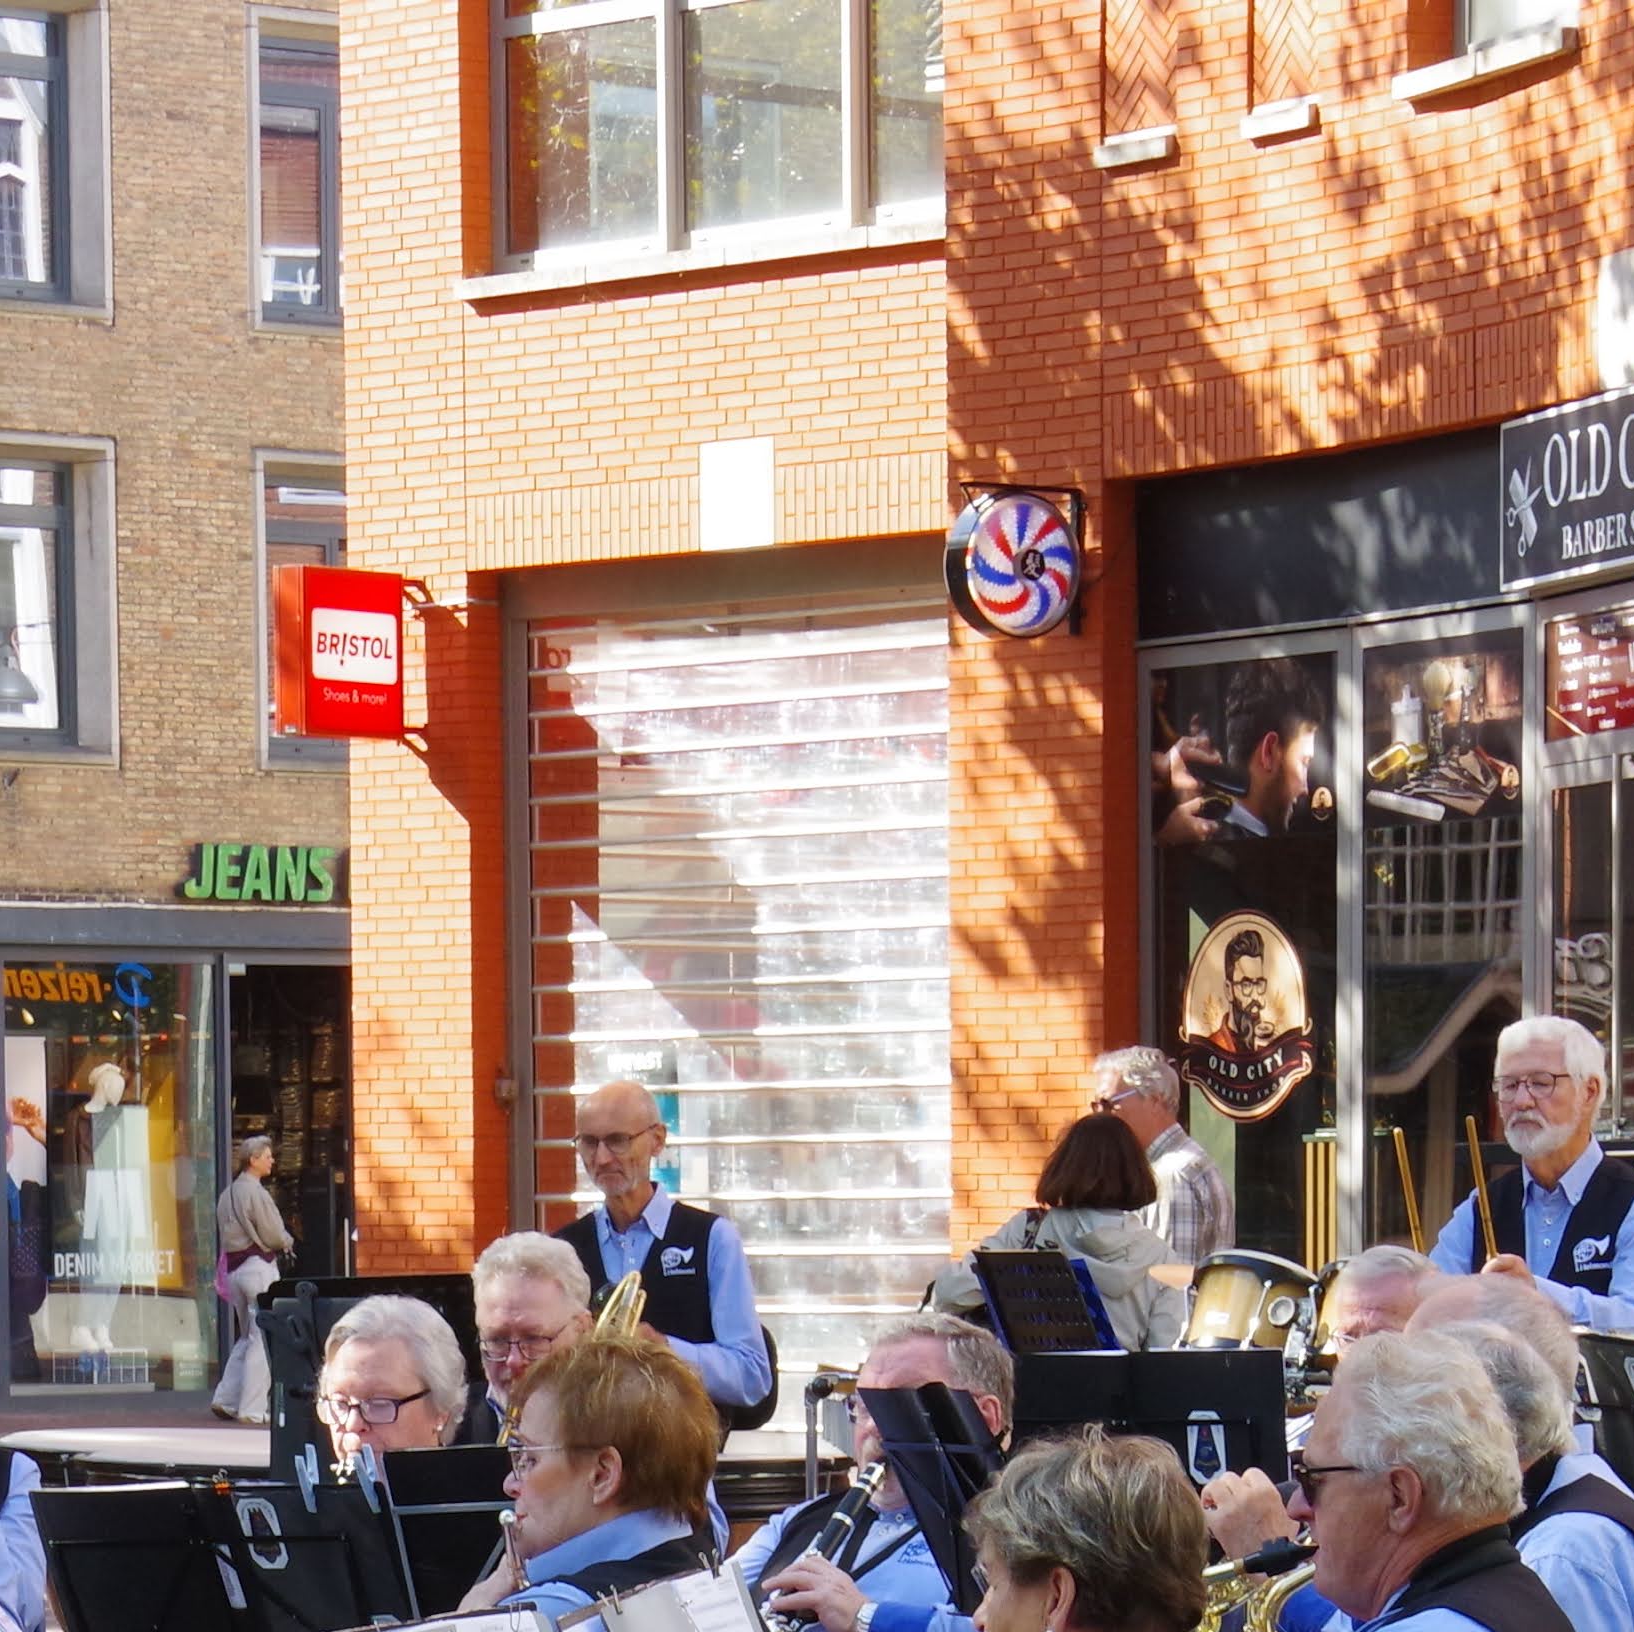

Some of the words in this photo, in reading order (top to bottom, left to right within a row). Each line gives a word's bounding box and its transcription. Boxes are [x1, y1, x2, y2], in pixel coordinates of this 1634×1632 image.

[1543, 422, 1612, 508] OLD
[1561, 513, 1628, 560] BARBER
[323, 686, 350, 703] Shoes
[351, 688, 360, 704] &
[183, 842, 335, 902] JEANS
[1207, 1054, 1239, 1079] OLD
[1246, 1047, 1284, 1080] CITY
[54, 1252, 103, 1278] DENIM
